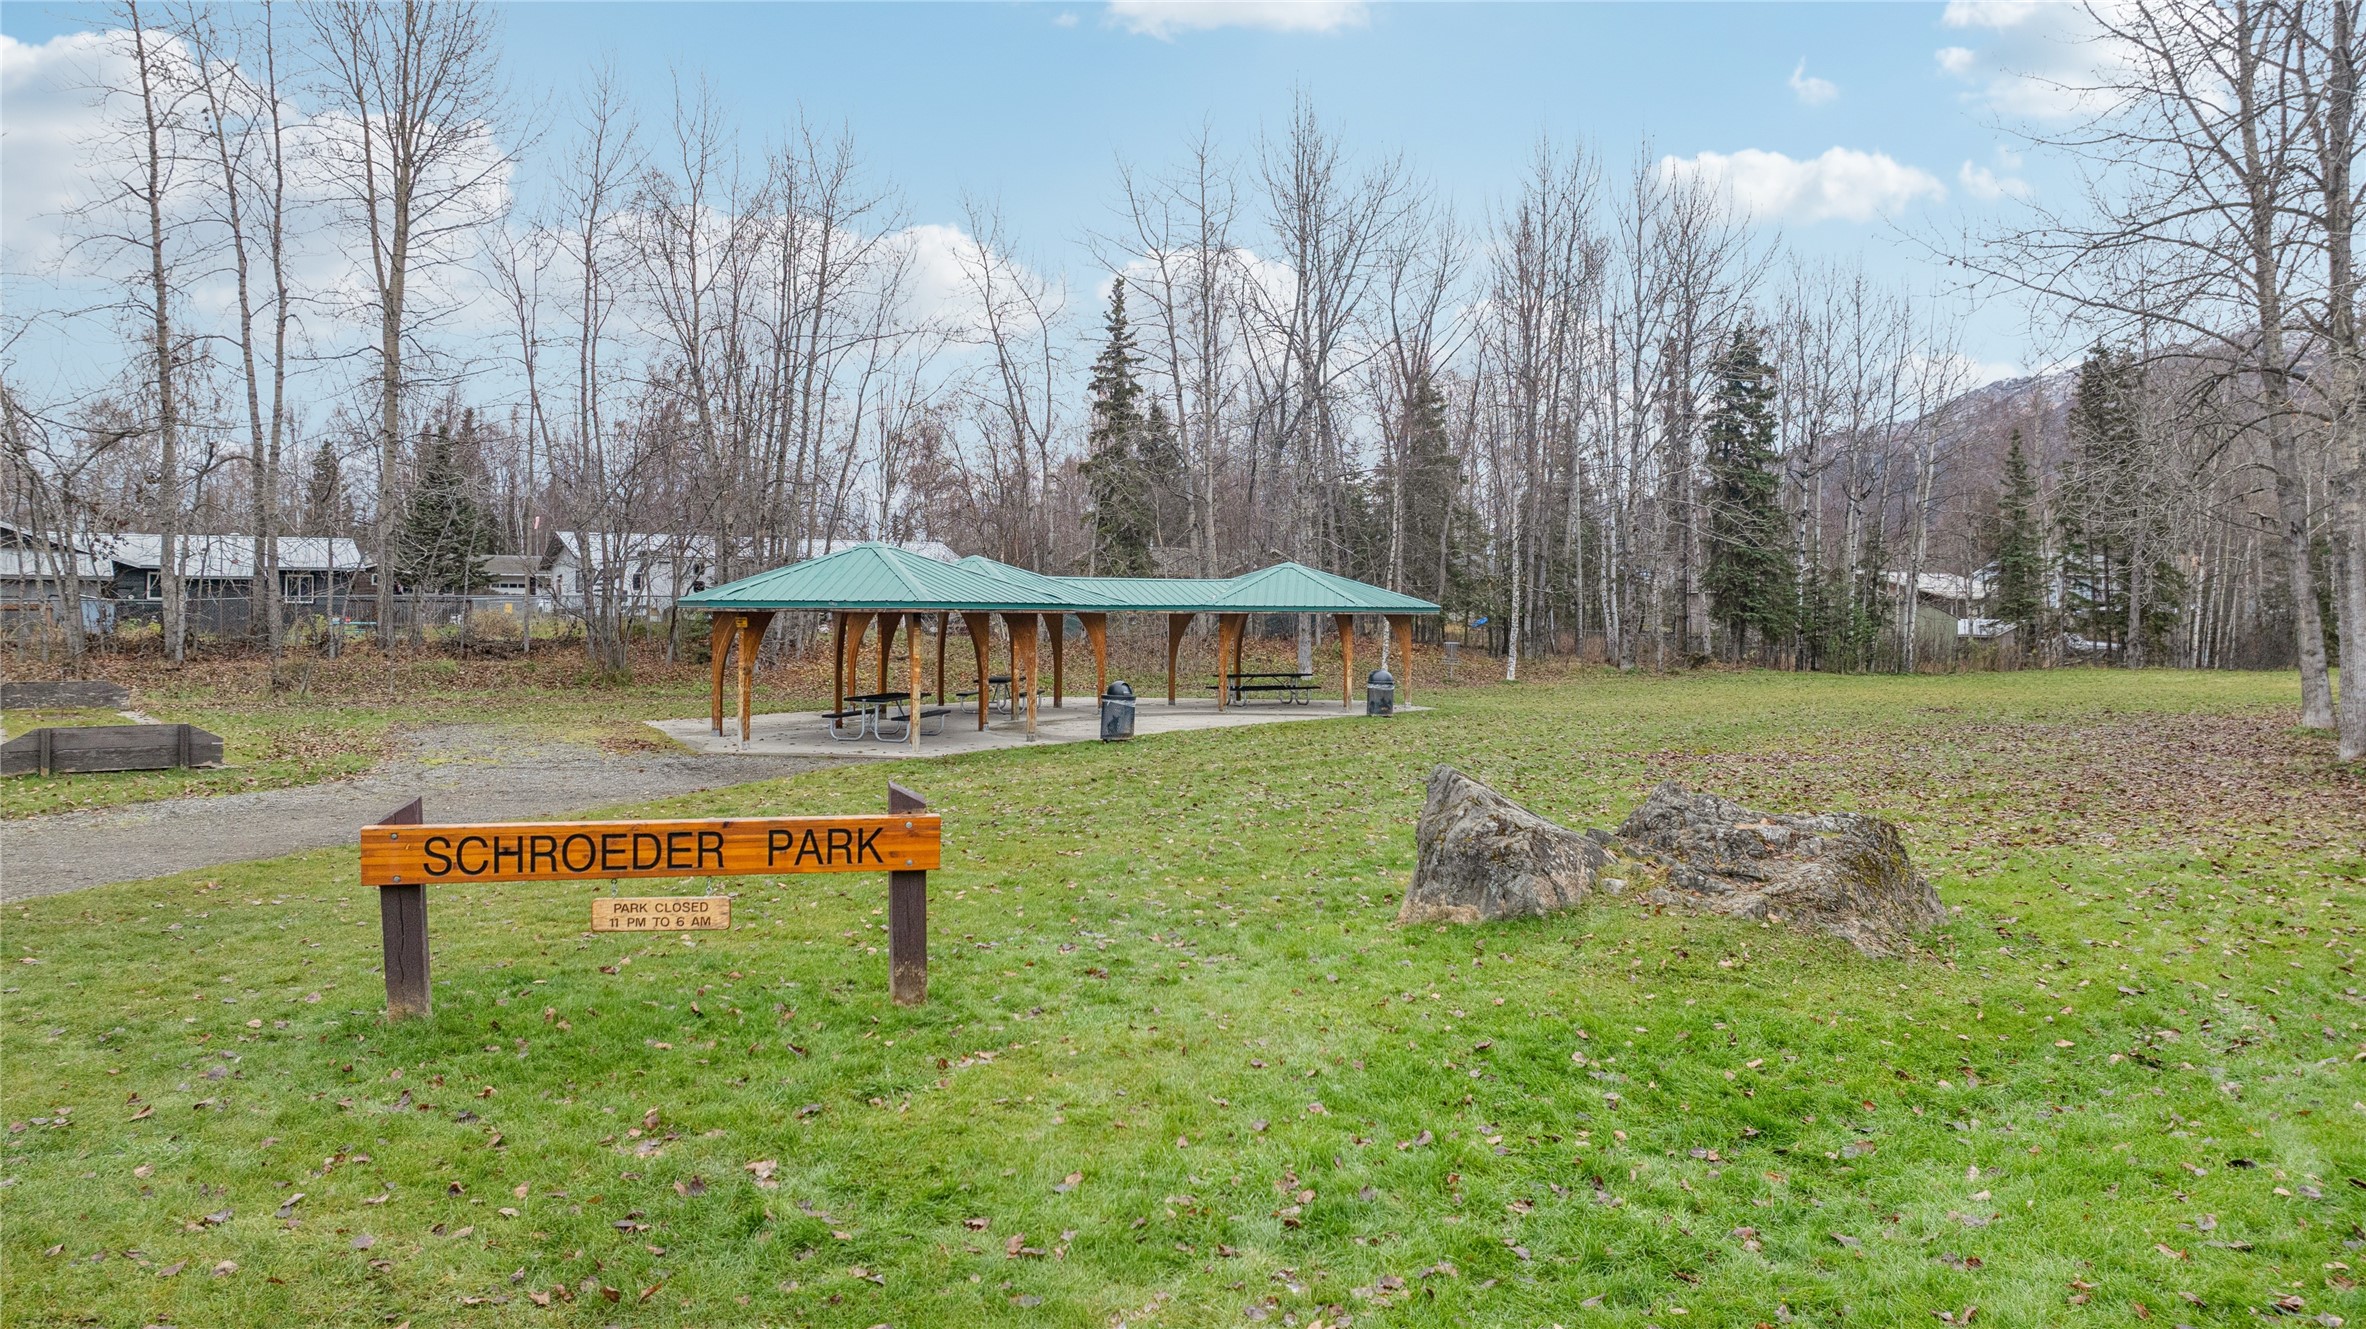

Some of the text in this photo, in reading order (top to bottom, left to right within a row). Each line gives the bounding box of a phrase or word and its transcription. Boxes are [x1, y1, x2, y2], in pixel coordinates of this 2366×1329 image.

[423, 827, 884, 876] SCHROEDER PARK
[613, 902, 709, 913] PARK CLOSED
[609, 916, 711, 927] 11 PM TO 6 AM
